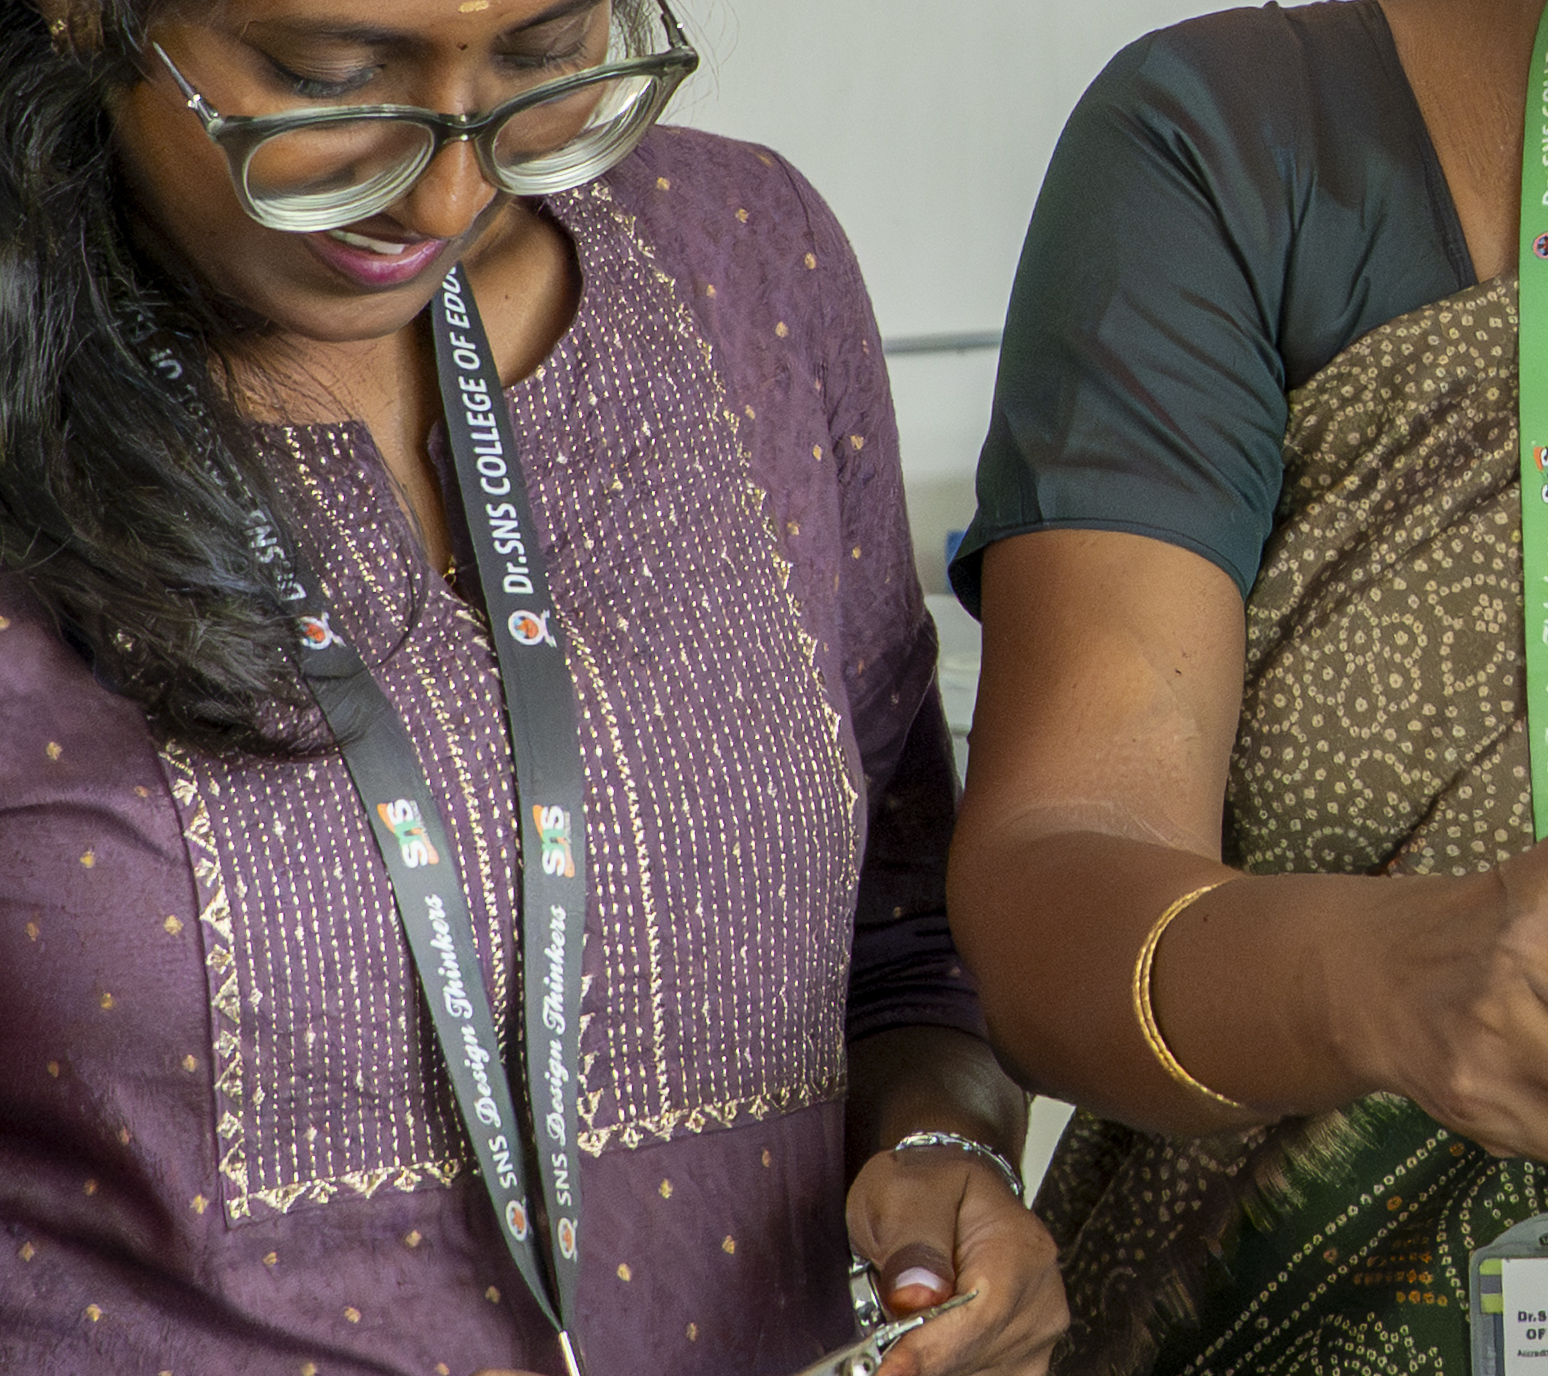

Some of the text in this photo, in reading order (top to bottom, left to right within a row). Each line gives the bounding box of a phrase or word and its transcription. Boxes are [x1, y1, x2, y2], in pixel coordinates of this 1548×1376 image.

[441, 266, 535, 595] Dr.SNS COLLEGE OF EDU
[424, 893, 518, 1189] SNS Design Thinkers
[543, 904, 572, 1207] SNS Design Thinkers
[1526, 1328, 1547, 1340] OF
